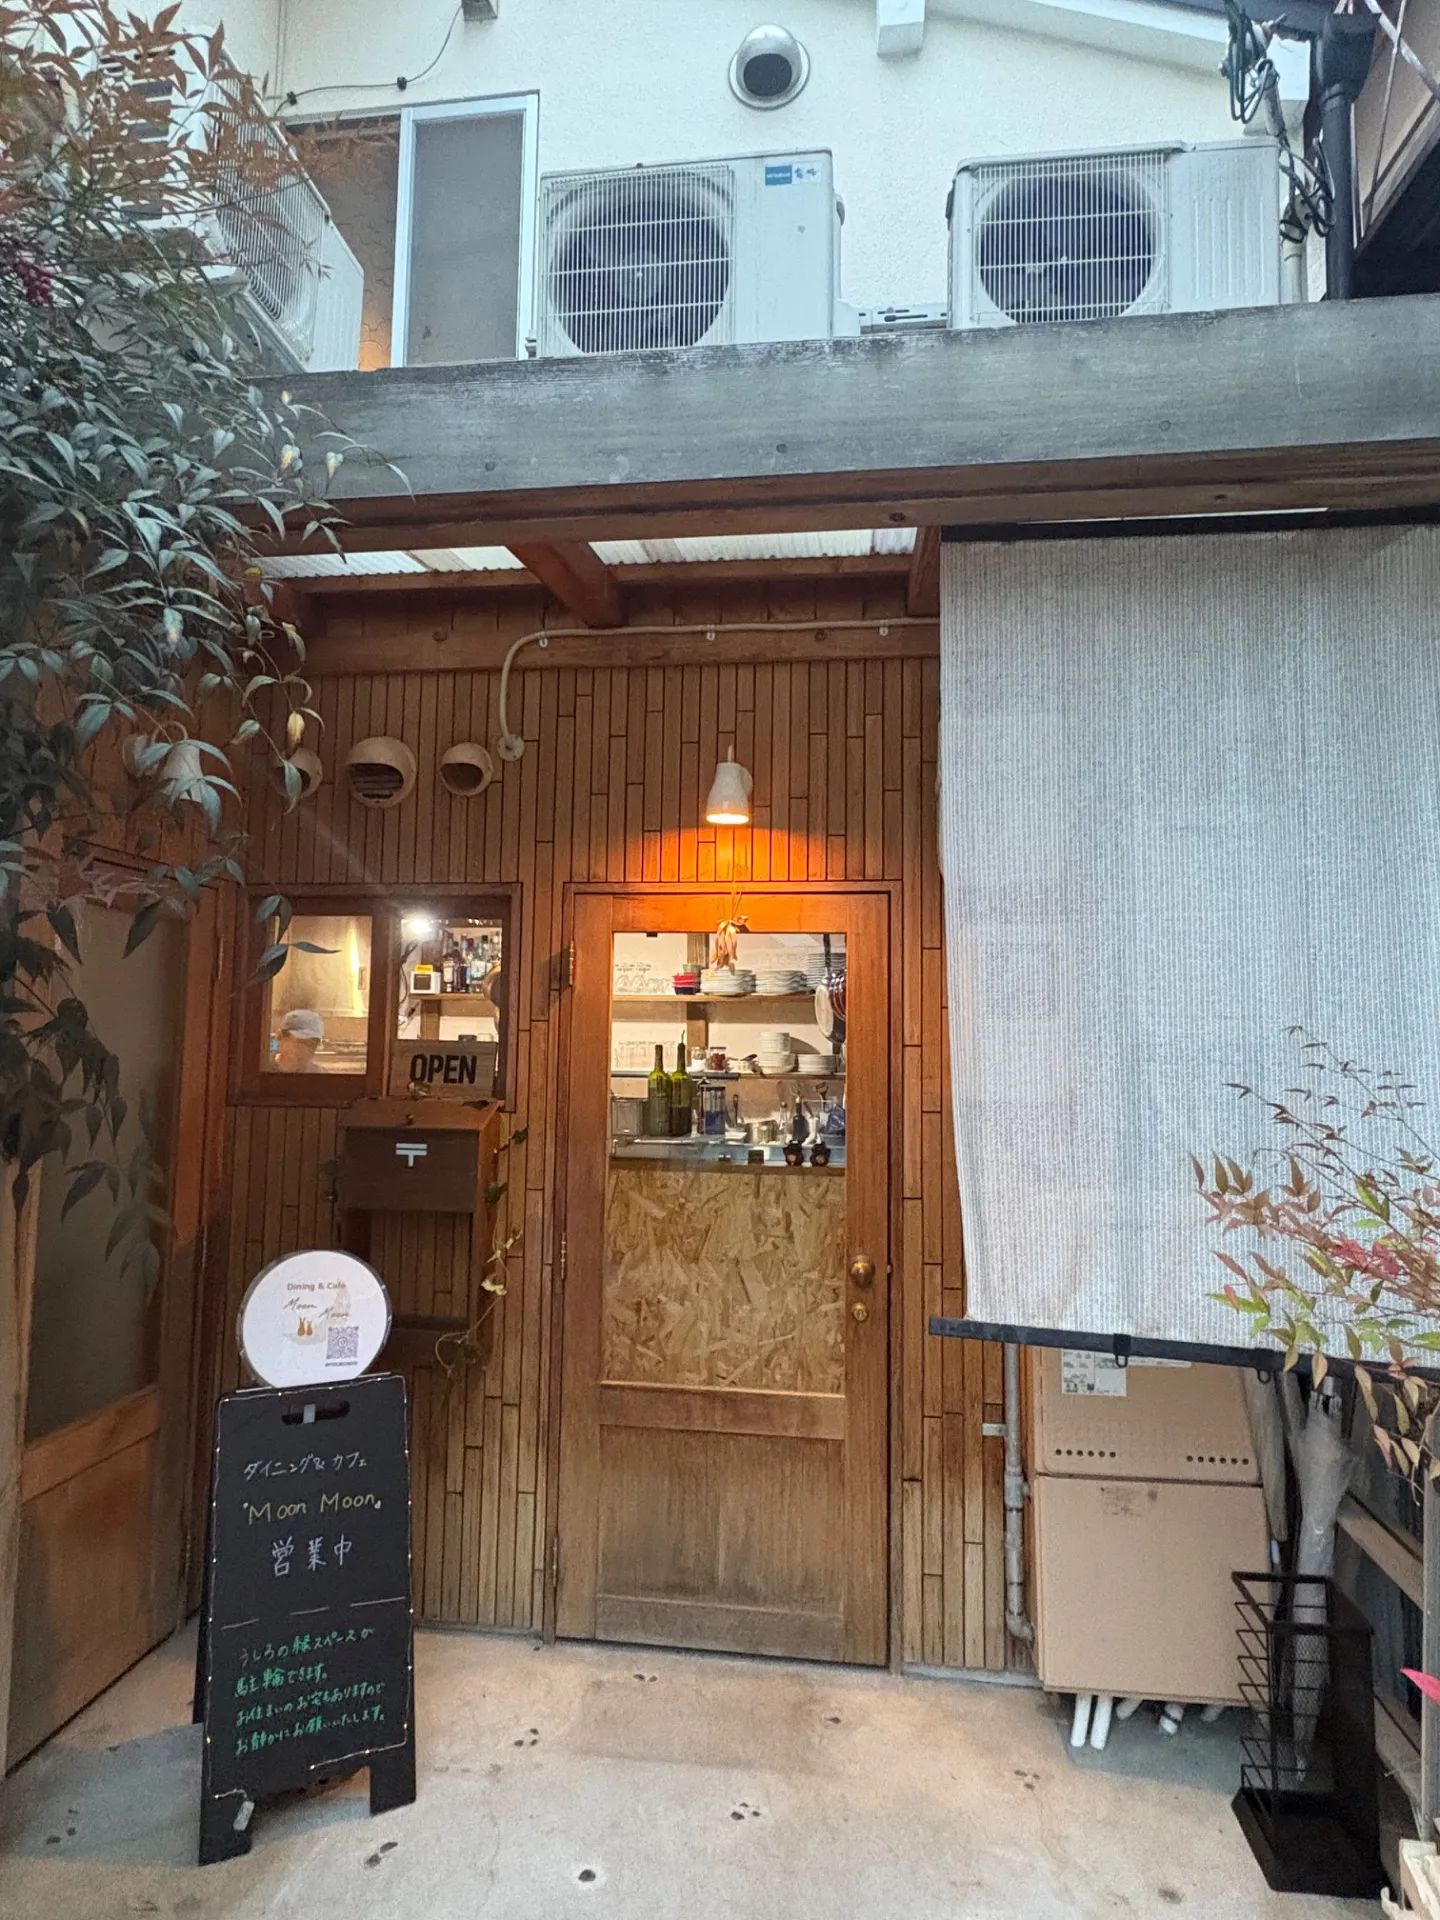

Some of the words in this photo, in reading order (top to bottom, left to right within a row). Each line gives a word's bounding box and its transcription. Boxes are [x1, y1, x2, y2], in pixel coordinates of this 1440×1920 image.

[410, 1053, 478, 1085] OPEN
[286, 1282, 315, 1292] Dining
[318, 1282, 325, 1290] &
[271, 1534, 352, 1577] 営業中
[234, 1663, 328, 1698] 駐輪できます。
